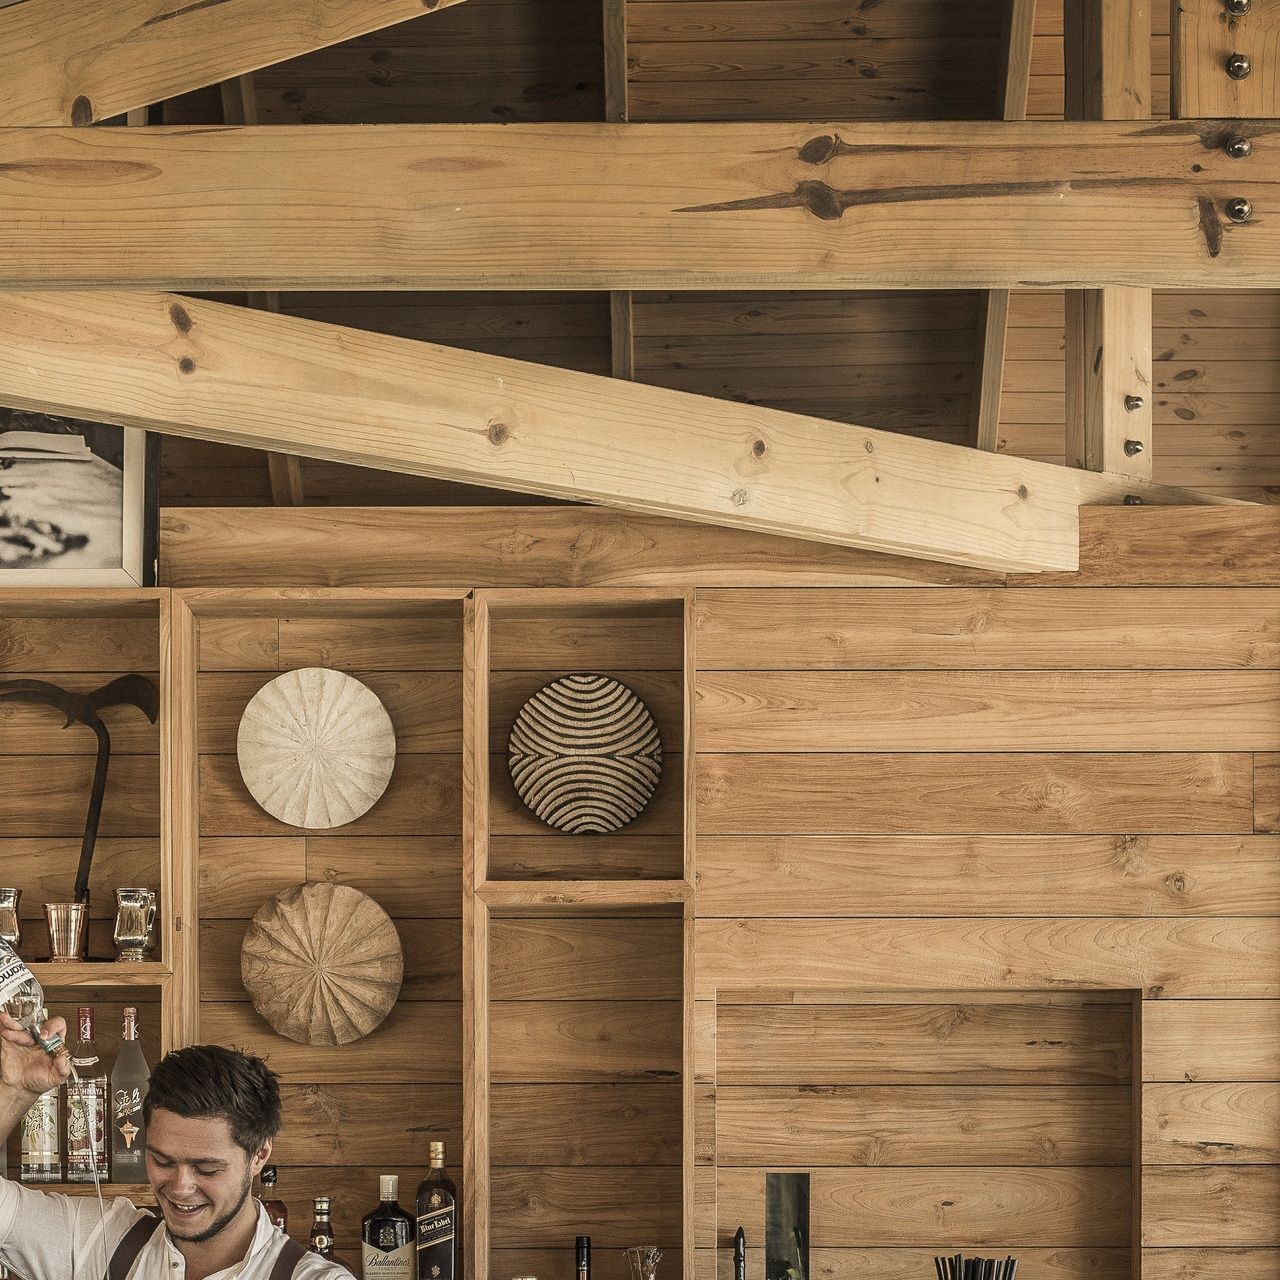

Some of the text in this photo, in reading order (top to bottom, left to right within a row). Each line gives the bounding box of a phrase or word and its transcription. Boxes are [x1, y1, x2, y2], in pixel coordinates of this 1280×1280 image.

[420, 1220, 435, 1234] Blue
[434, 1217, 452, 1230] Label
[365, 1253, 411, 1268] Ballantine's
